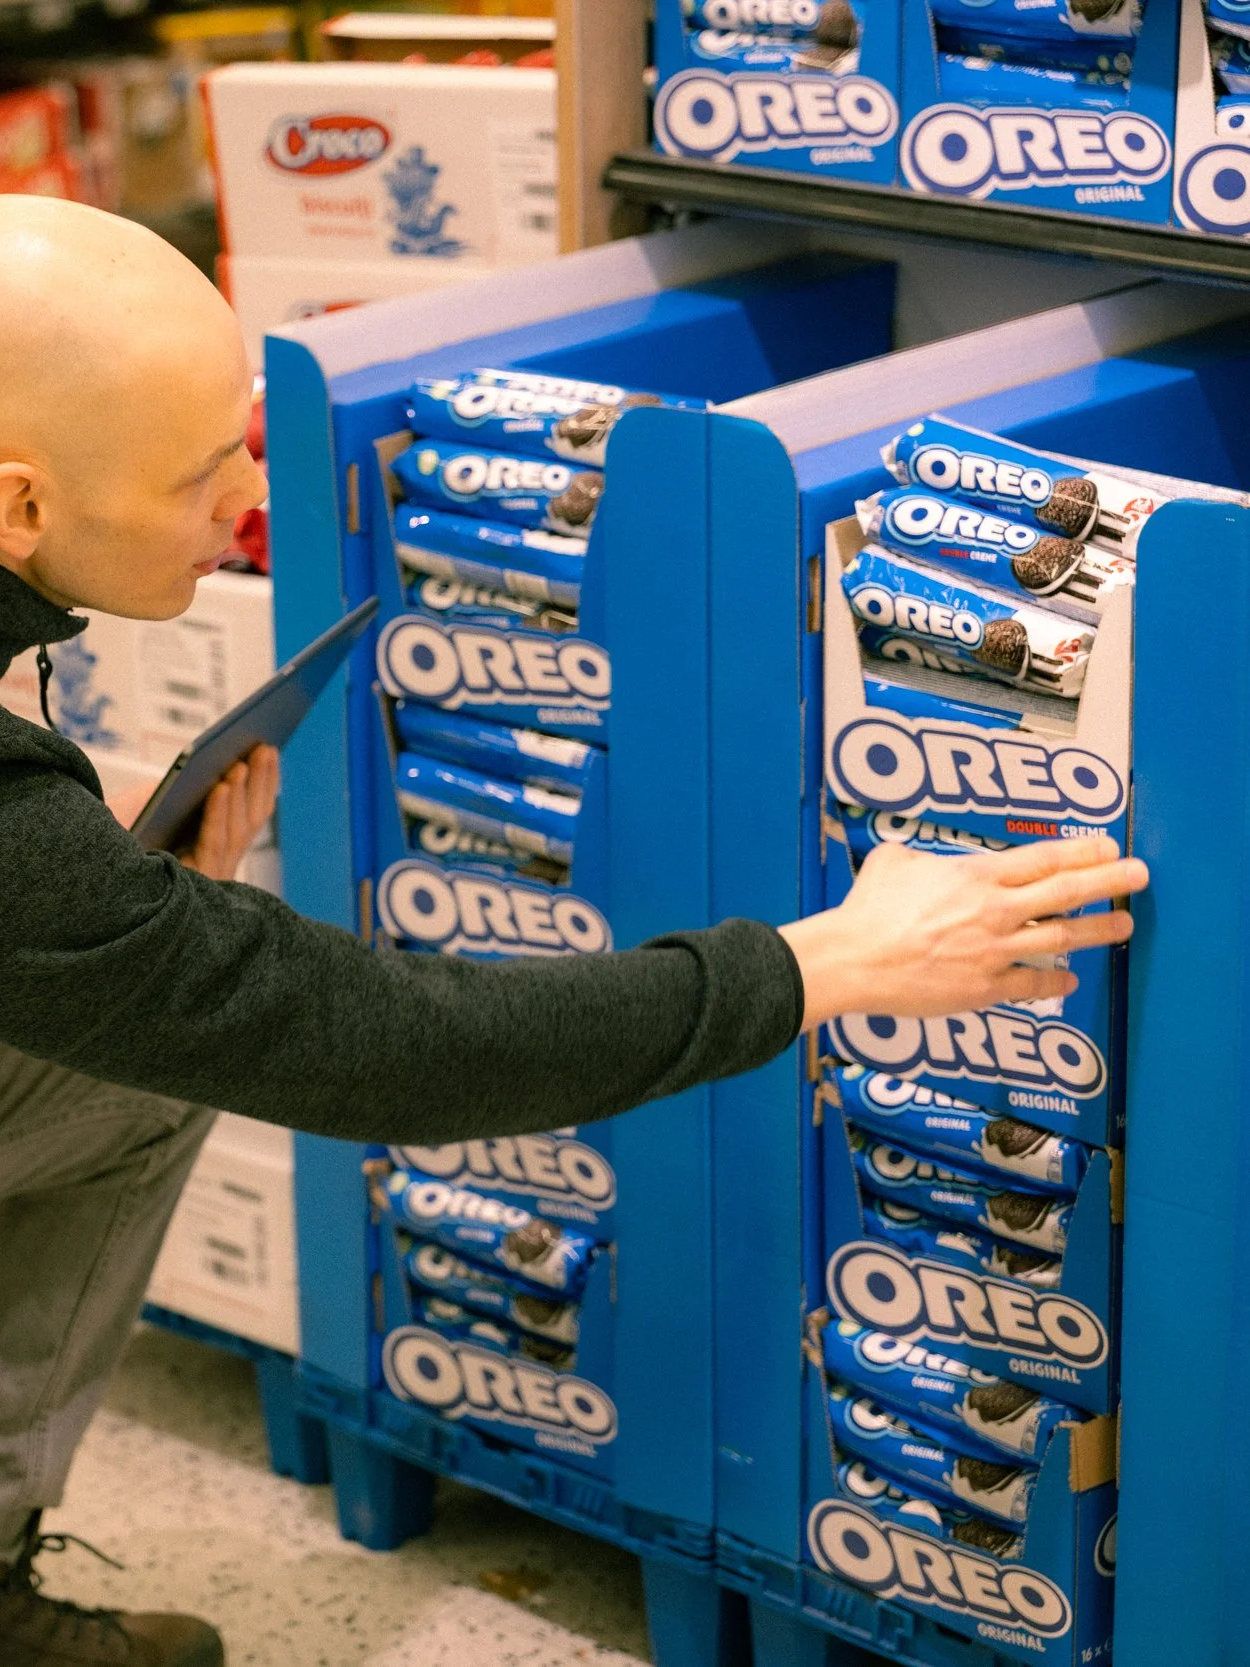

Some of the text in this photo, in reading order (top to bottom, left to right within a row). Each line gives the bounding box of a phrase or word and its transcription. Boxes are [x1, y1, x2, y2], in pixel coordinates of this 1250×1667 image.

[270, 113, 385, 169] Croco
[666, 78, 892, 153] OREO
[914, 112, 1165, 188] OREO
[1074, 186, 1145, 205] ORIGINAL
[443, 454, 572, 495] OREO
[915, 448, 1052, 502] OREO
[893, 498, 1038, 549] OREO
[969, 550, 998, 564] CREME
[853, 587, 982, 646] OREO
[388, 622, 611, 698] OREO
[839, 722, 1120, 811] OREO
[1006, 819, 1108, 839] DOUBLE CREME
[389, 868, 608, 952] OREO
[842, 1012, 1100, 1086] OREO
[925, 1115, 971, 1132] ORIGINAL
[1008, 1090, 1080, 1116] ORIGINAL
[930, 1190, 976, 1207] ORIGINAL
[841, 1252, 1101, 1357] OREO
[393, 1335, 611, 1436] OREO
[911, 1376, 956, 1394] ORIGINAL
[1008, 1358, 1082, 1385] ORIGINAL
[901, 1443, 945, 1462] ORIGINAL
[820, 1510, 1063, 1626] OREO
[977, 1622, 1047, 1652] ORIGINAL
[1081, 1648, 1093, 1664] 16
